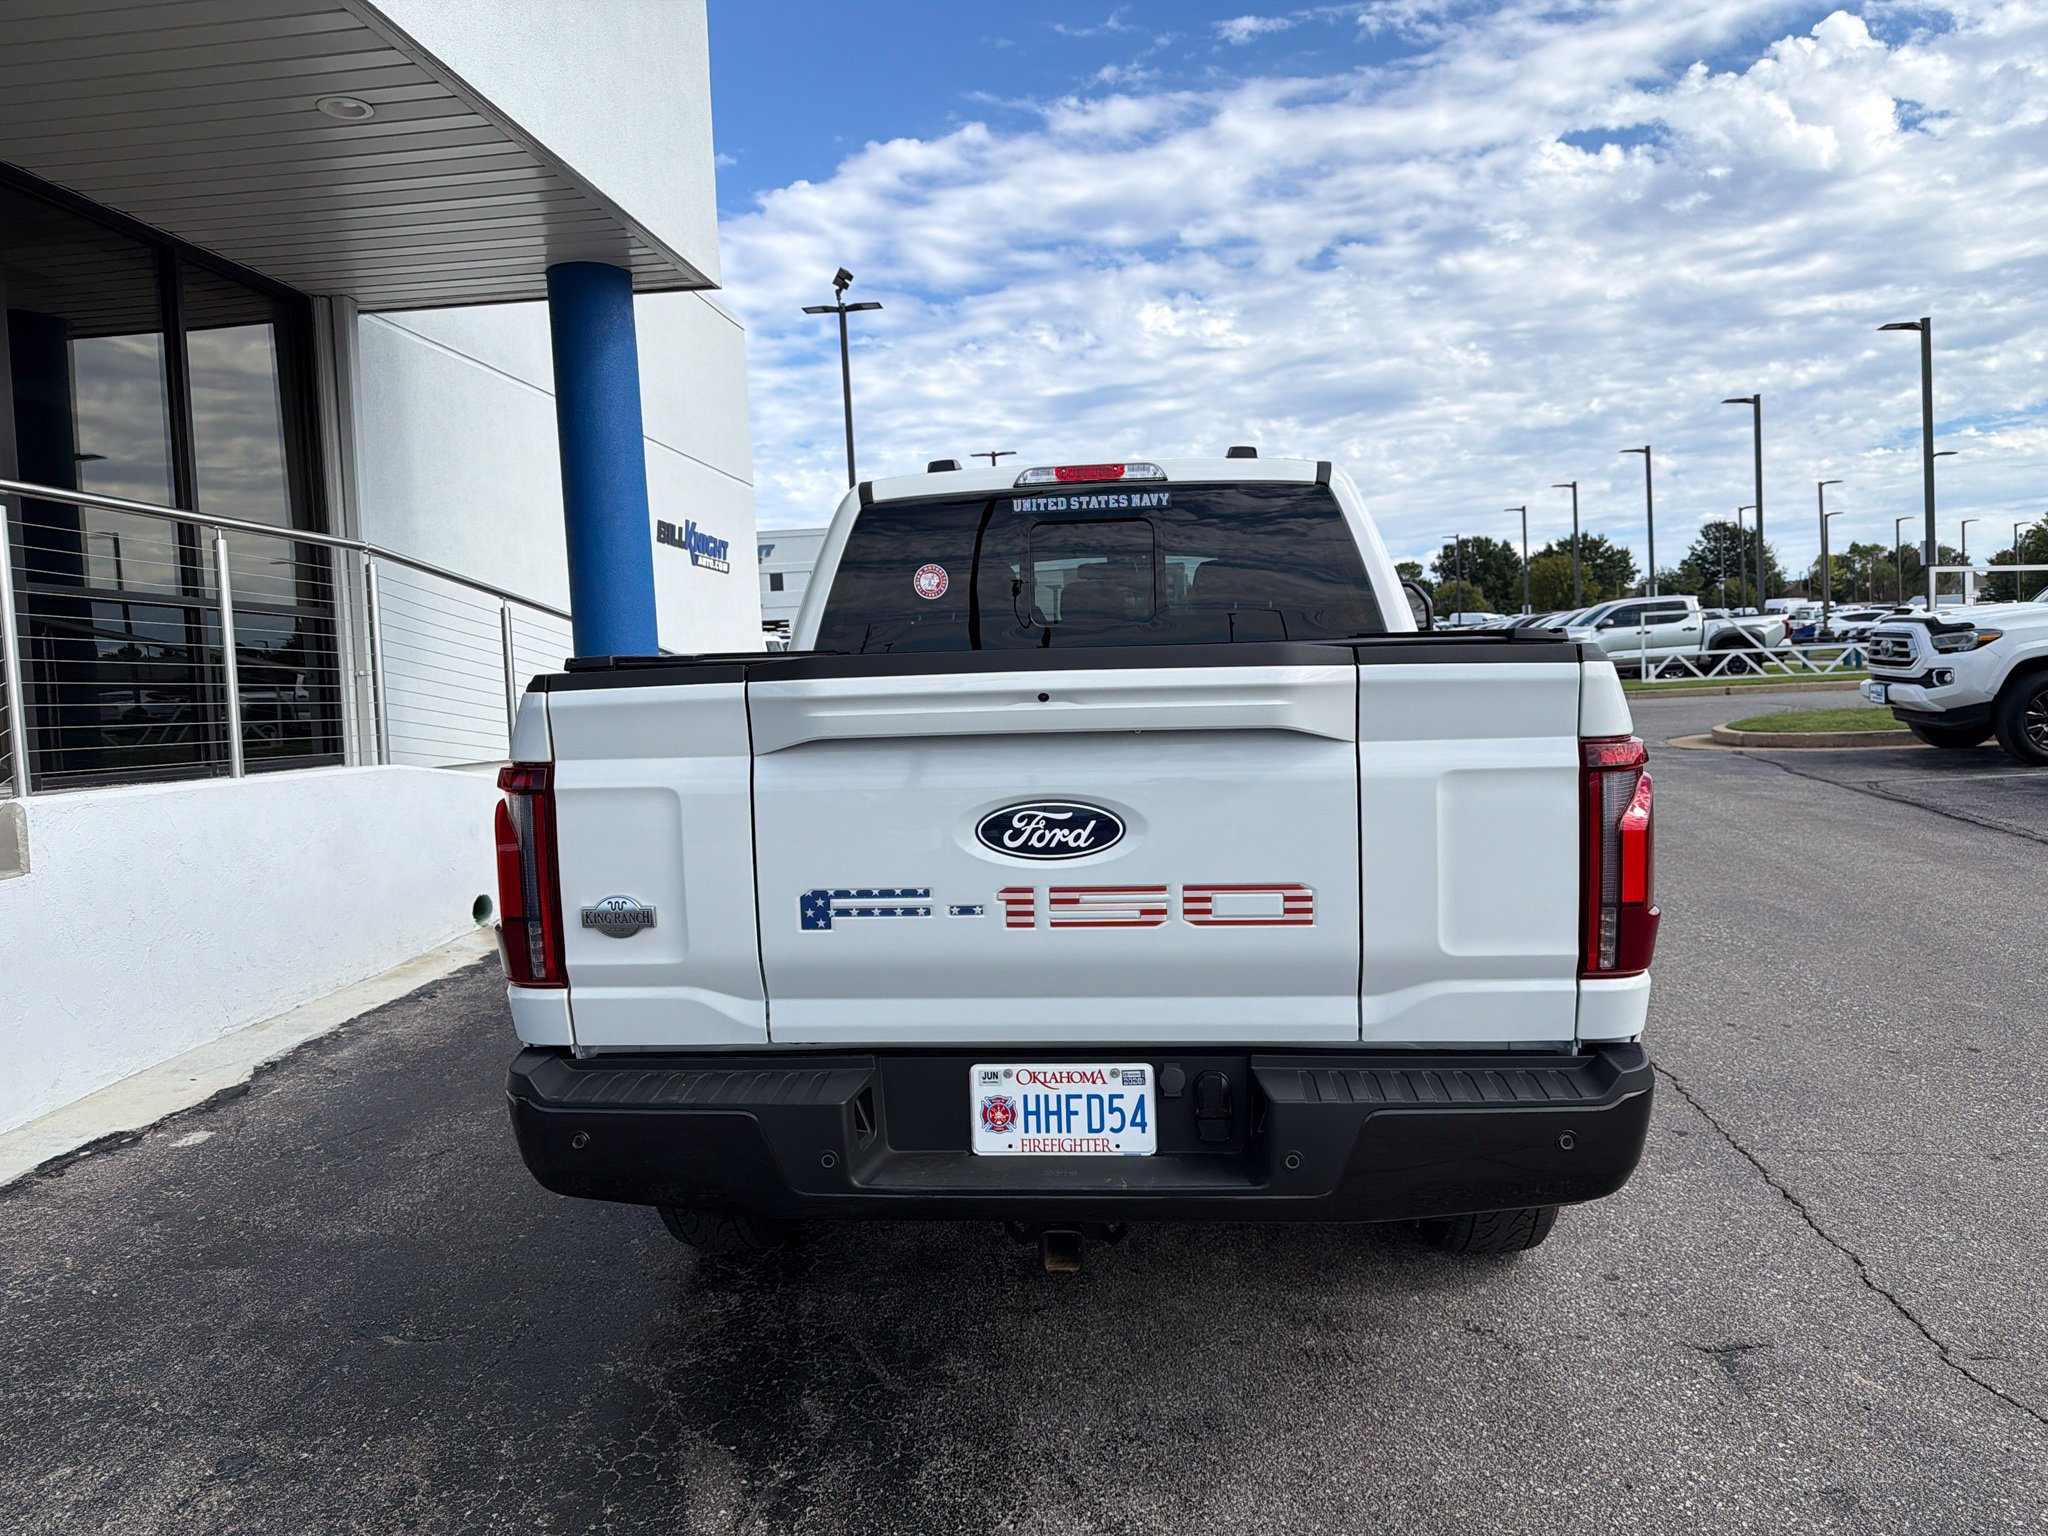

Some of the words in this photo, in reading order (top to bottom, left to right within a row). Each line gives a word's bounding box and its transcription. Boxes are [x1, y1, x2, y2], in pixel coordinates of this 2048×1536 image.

[1013, 498, 1067, 512] UNITED
[1070, 494, 1128, 510] STATES
[1131, 492, 1170, 507] NAVY
[657, 519, 687, 550] BILL
[685, 519, 729, 566] KNIGHT
[697, 556, 728, 572] AUTO.COM
[1003, 810, 1095, 848] Ford
[585, 911, 611, 924] KING
[614, 911, 651, 924] RANCH
[801, 886, 1314, 930] F-150
[982, 1071, 999, 1080] JUN
[1016, 1069, 1107, 1090] OKLAHOMA
[1023, 1094, 1147, 1134] HHFD54
[1021, 1138, 1113, 1153] FIREFIGHTER
